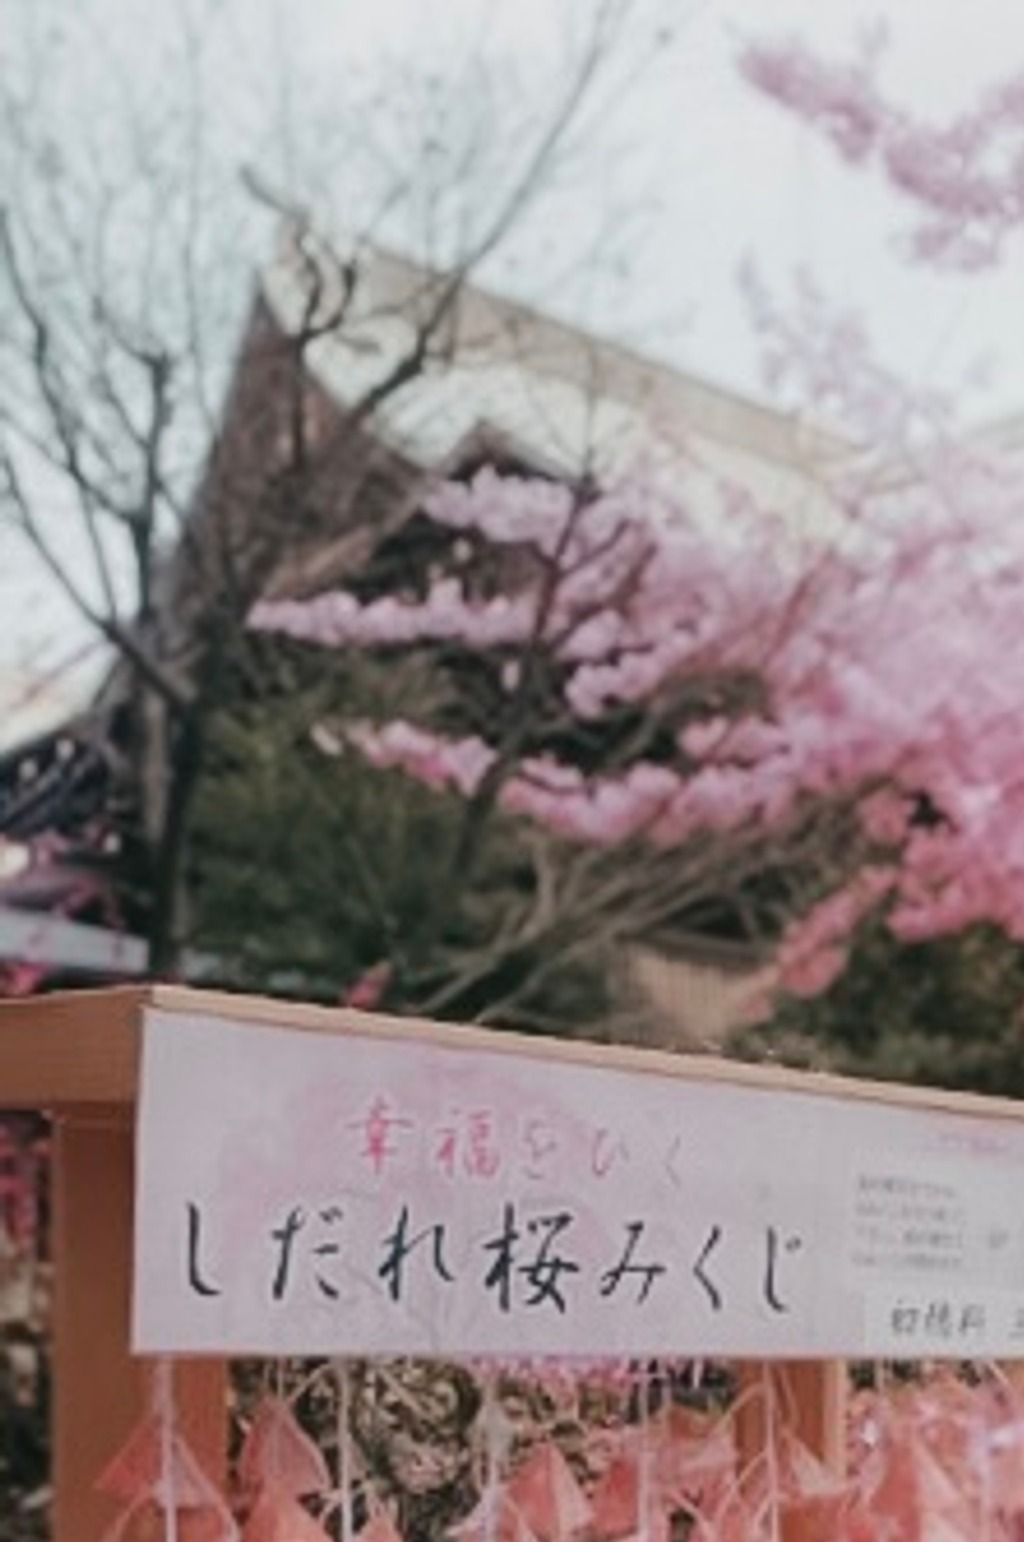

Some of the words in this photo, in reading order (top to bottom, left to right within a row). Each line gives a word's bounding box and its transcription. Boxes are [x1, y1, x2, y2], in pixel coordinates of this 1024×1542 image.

[185, 1200, 804, 1313] しだれ桜みくじ
